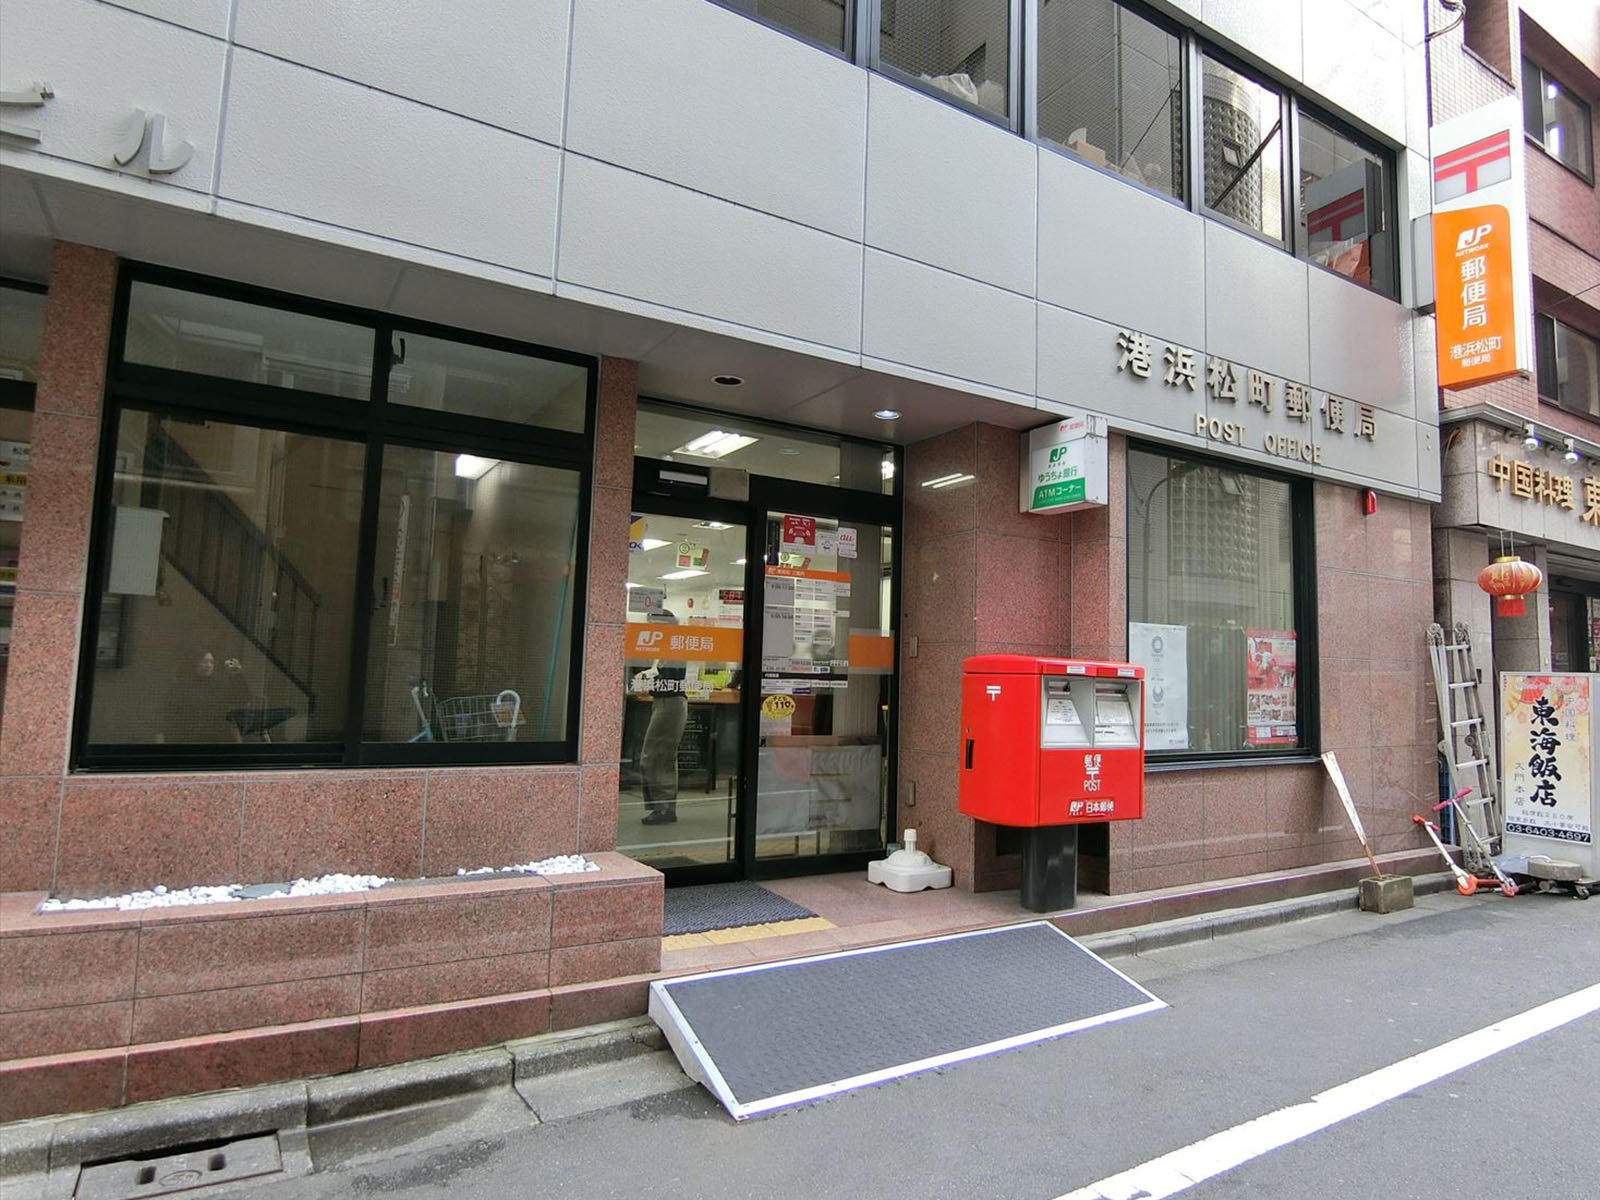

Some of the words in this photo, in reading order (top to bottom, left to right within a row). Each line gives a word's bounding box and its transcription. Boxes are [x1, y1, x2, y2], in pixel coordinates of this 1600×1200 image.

[1461, 255, 1488, 330] 郵便局
[1450, 336, 1502, 360] 港浜松町
[1461, 354, 1491, 367] 郵便局
[1115, 329, 1377, 442] 港浜松町郵便局
[1194, 413, 1245, 446] POST
[1264, 432, 1322, 464] OFFICE
[1038, 466, 1077, 483] ゆうちょ銀行
[1488, 454, 1577, 510] 中国料理
[1039, 484, 1082, 499] ATMコーナー
[670, 635, 714, 652] 郵便局
[1529, 696, 1562, 807] 東海飯店
[1083, 780, 1101, 792] POST
[1086, 800, 1114, 813] 日本郵便
